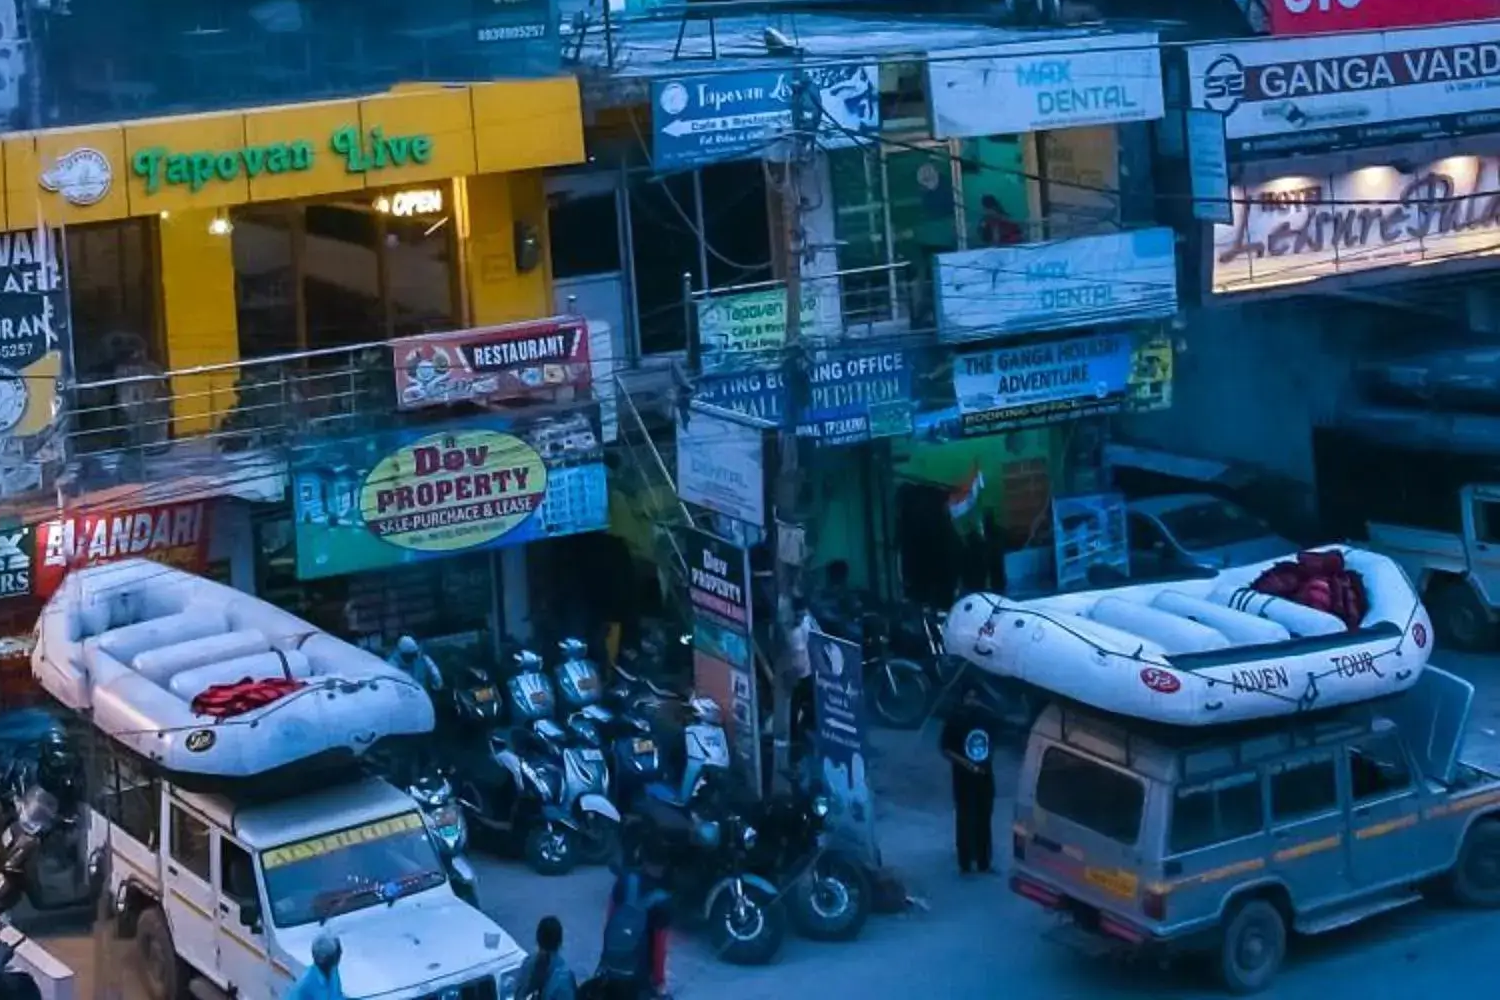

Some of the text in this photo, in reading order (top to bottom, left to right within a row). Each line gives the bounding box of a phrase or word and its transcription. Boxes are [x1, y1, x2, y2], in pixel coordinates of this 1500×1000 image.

[1016, 60, 1073, 87] MAX
[1259, 55, 1395, 98] GANGA
[698, 83, 764, 111] Tapovan
[1037, 86, 1137, 115] DENTAL
[134, 137, 313, 194] Tapovan
[332, 124, 434, 174] Live
[391, 189, 442, 217] OPEN
[474, 334, 566, 367] RESTAURANT
[848, 352, 904, 377] OFFICE
[963, 355, 995, 376] THE
[998, 347, 1054, 371] GANGA
[999, 363, 1089, 394] ADVENTURE
[376, 466, 530, 514] PROPERTY
[496, 496, 533, 517] LEASE
[1232, 652, 1384, 694] ADVEN TOUR
